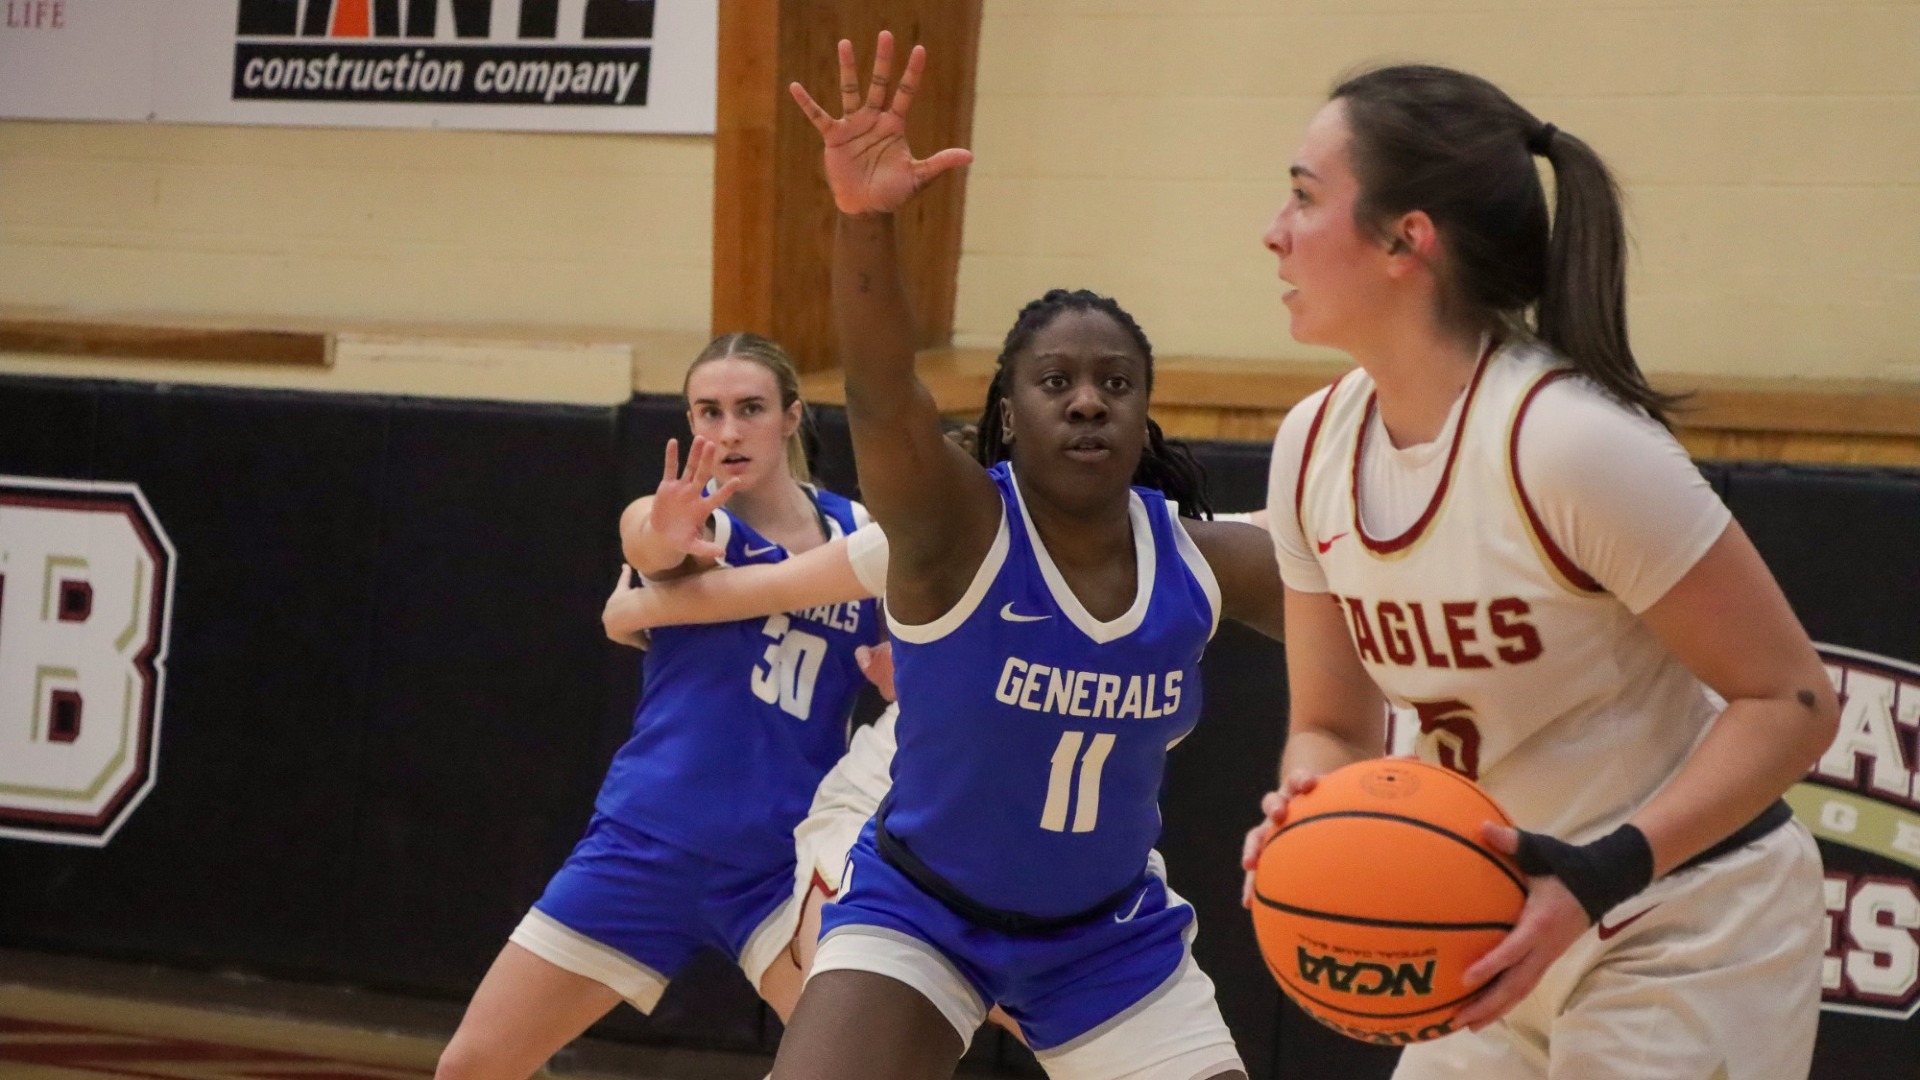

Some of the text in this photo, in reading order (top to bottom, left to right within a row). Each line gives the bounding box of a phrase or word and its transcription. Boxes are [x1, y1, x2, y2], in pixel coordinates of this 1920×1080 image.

[7, 1, 65, 29] LIFE
[243, 50, 641, 104] construction company
[1331, 594, 1544, 669] AGLES
[751, 614, 828, 721] 30
[995, 656, 1184, 719] GENERALS
[1039, 731, 1117, 833] 11
[1296, 945, 1437, 998] NCAA
